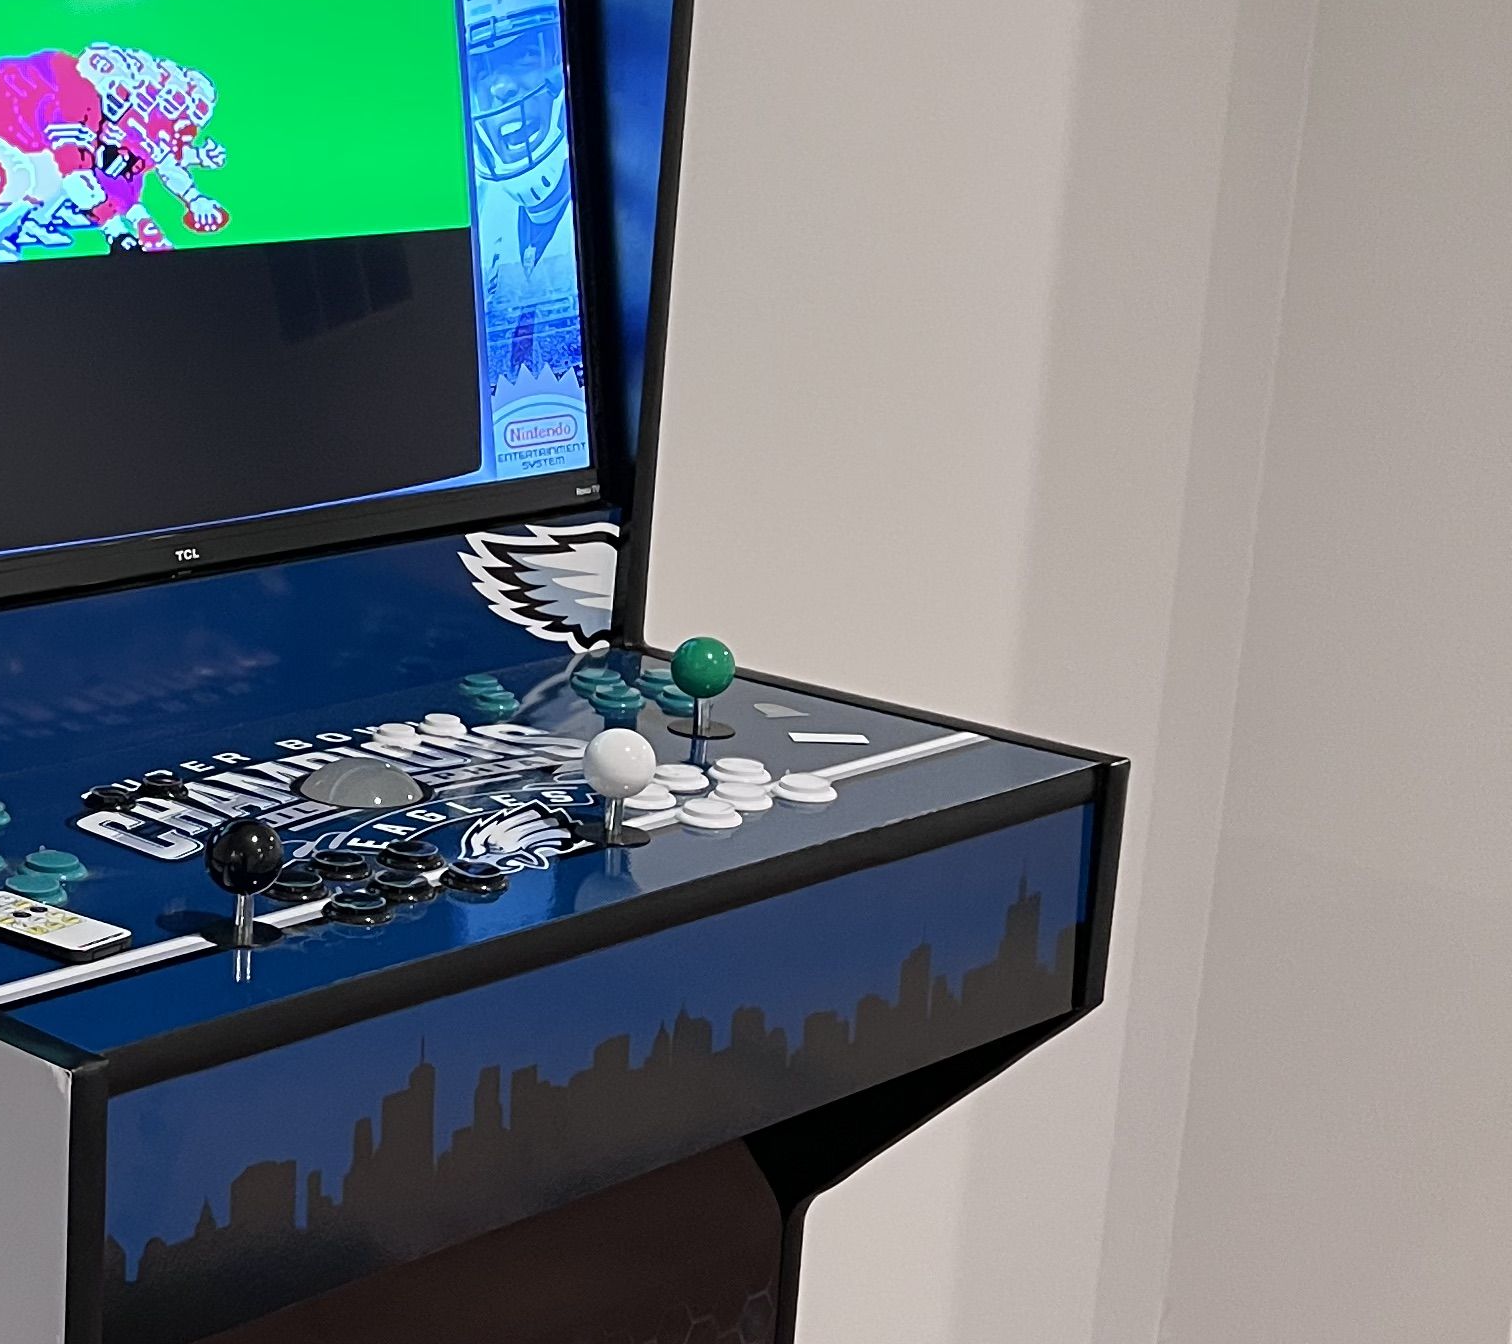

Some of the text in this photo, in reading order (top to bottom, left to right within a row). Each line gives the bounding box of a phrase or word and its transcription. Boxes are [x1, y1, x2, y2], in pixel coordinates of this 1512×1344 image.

[509, 422, 571, 442] Nintendo
[497, 442, 586, 463] ENTERTAINMENT
[522, 456, 565, 470] SYSTEM
[175, 549, 199, 561] TCL
[80, 751, 252, 800] UER
[347, 790, 574, 850] EAGLES
